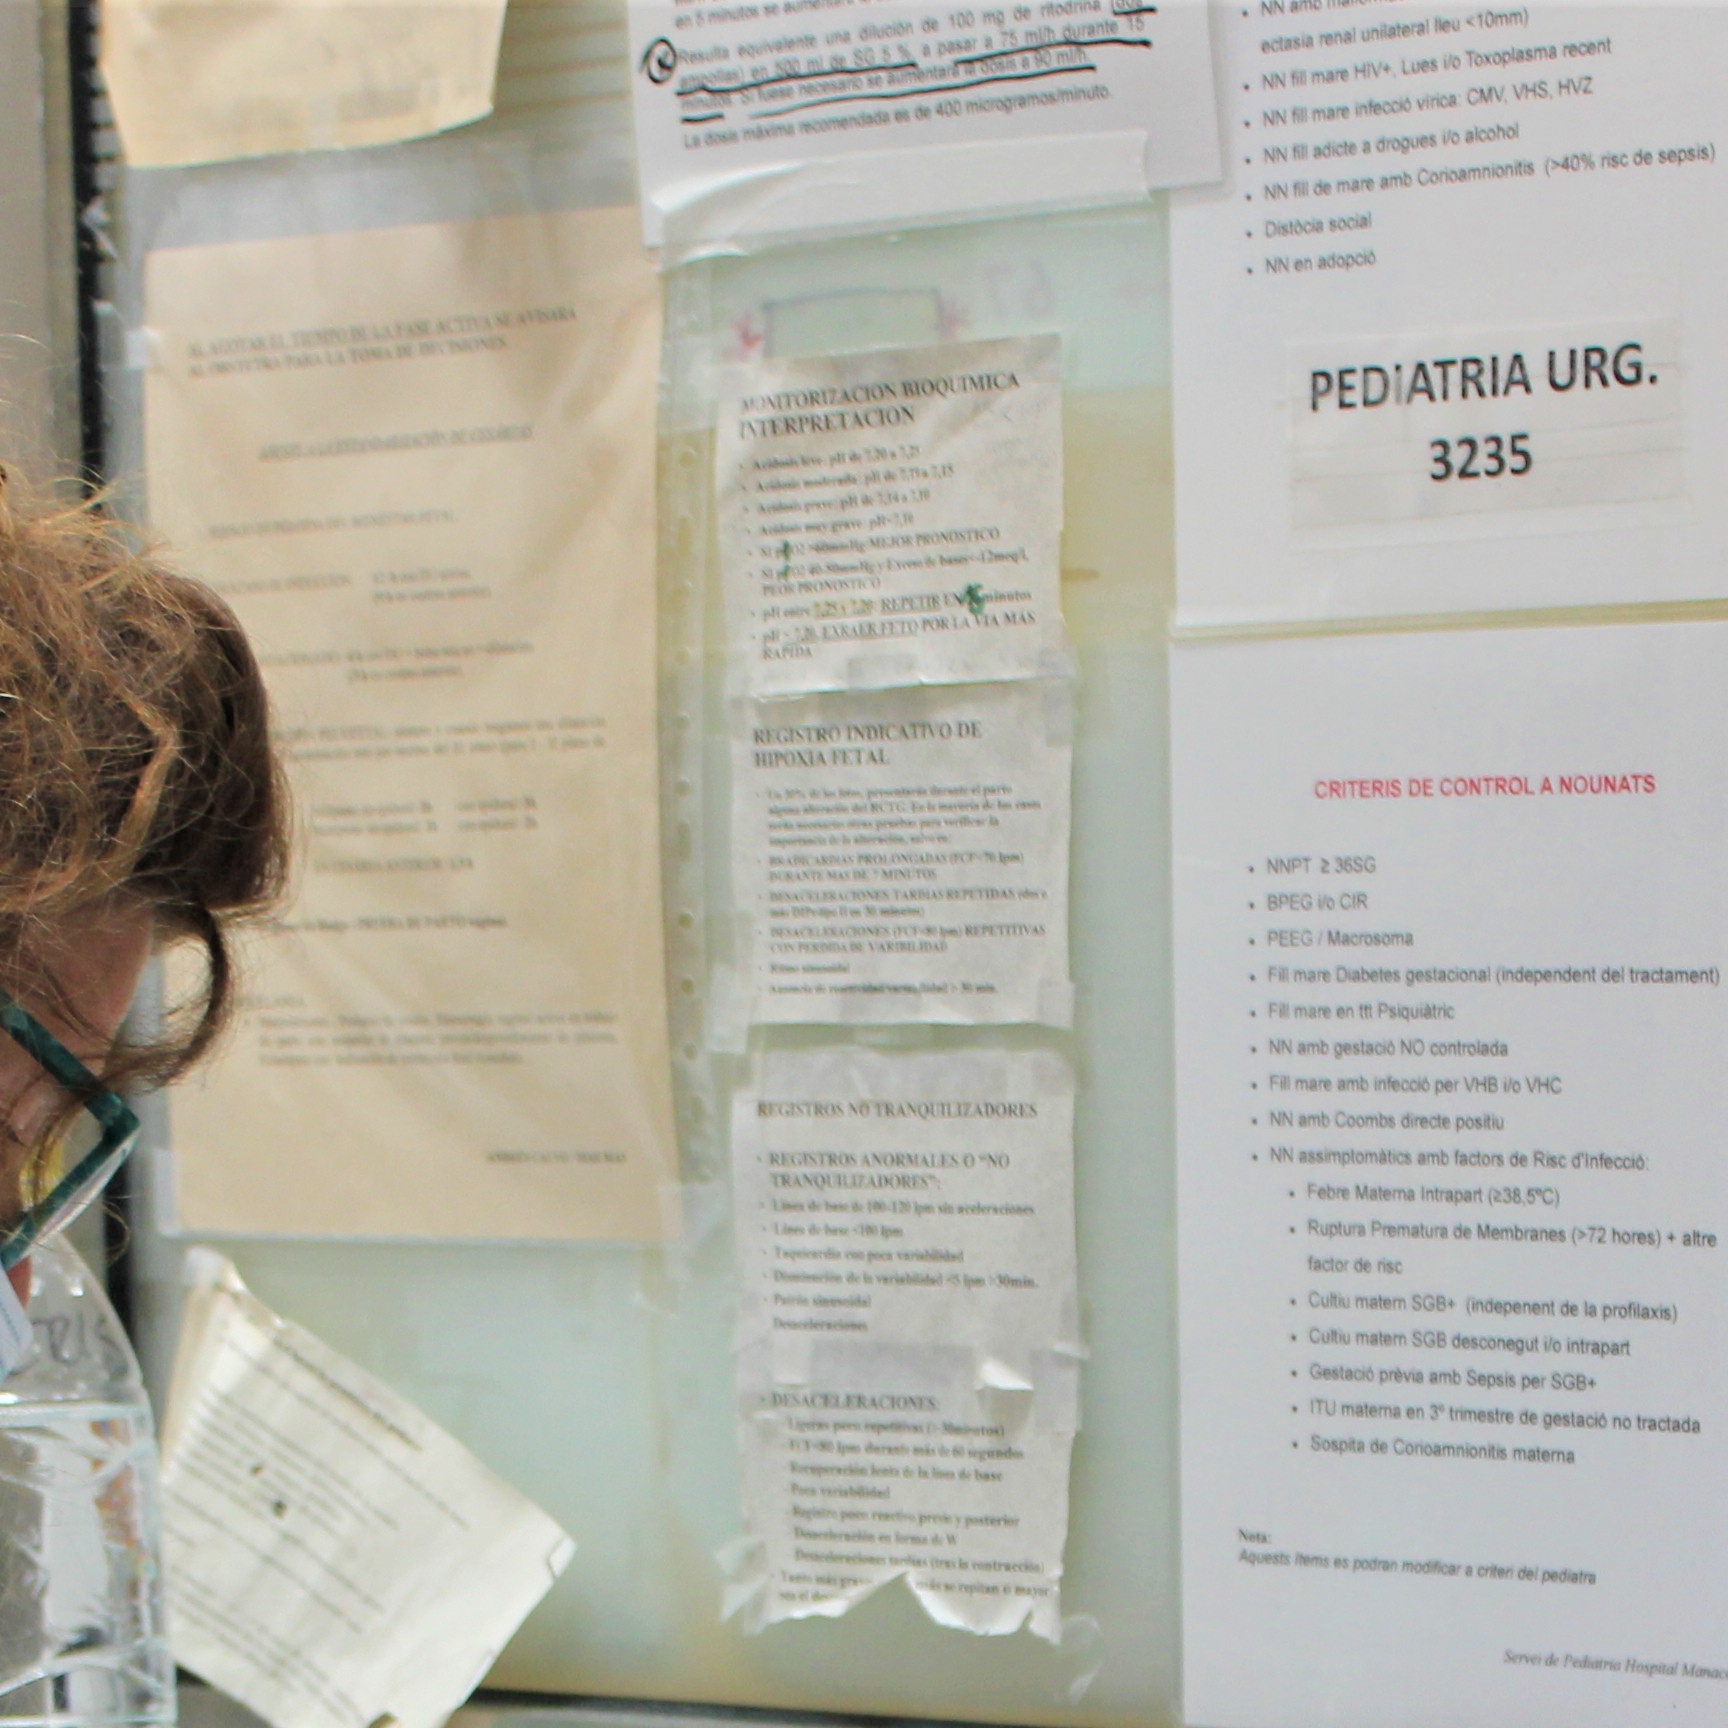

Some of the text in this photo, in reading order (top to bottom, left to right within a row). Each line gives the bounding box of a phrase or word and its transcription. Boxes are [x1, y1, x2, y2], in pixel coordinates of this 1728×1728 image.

[1311, 341, 1657, 412] PEDIATRIA URG.
[1431, 432, 1532, 482] 3235
[1315, 773, 1656, 799] CRITERIS DE CONTROL A NOUNATS
[1269, 1037, 1508, 1060] NN amb gestació NO controlada
